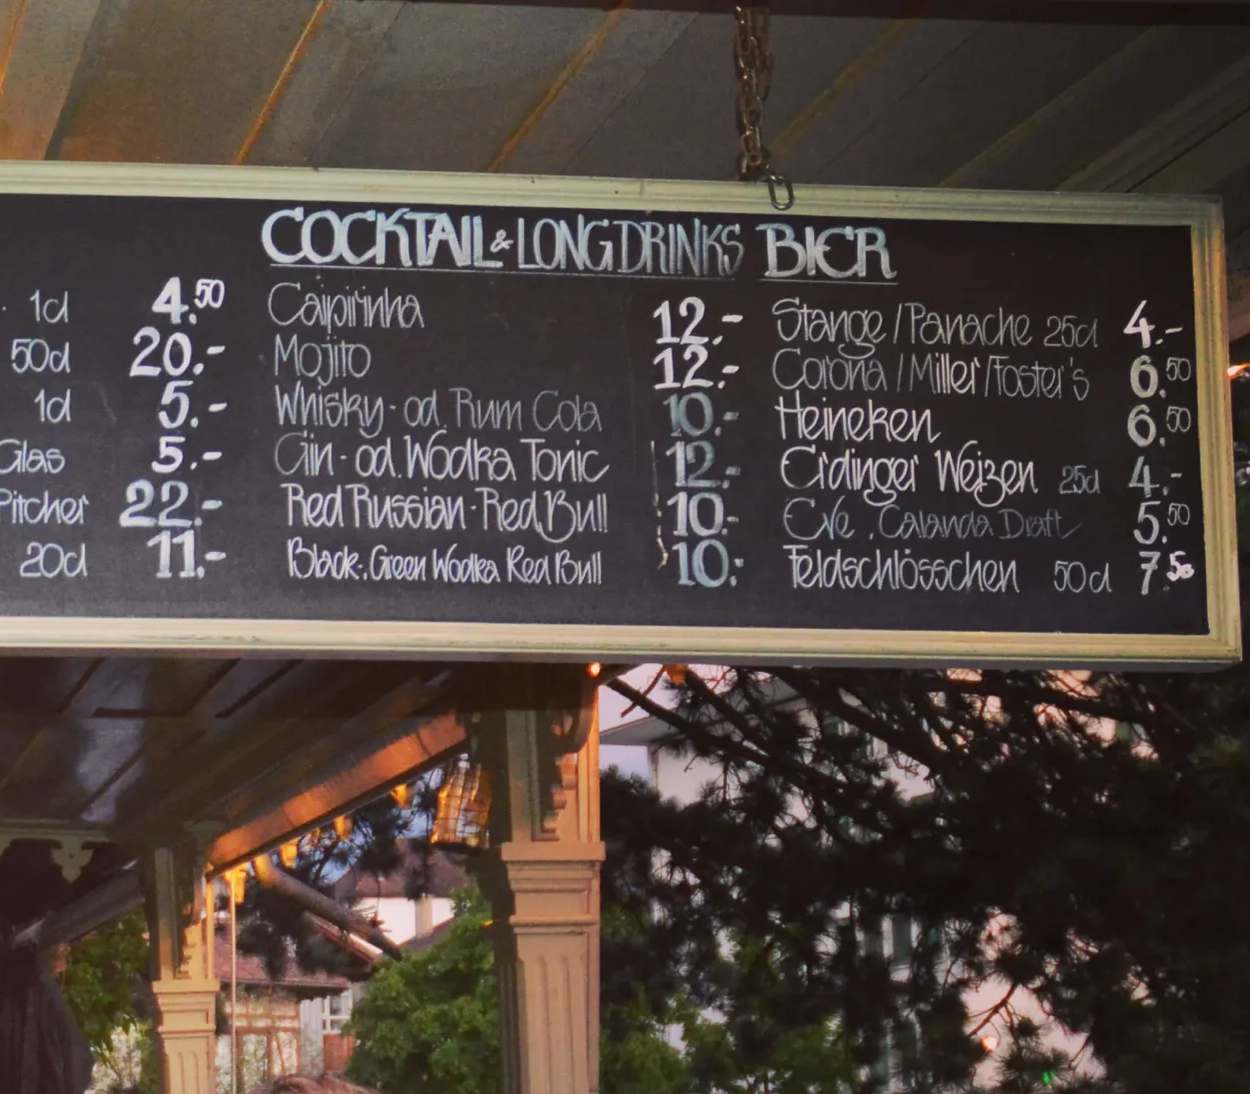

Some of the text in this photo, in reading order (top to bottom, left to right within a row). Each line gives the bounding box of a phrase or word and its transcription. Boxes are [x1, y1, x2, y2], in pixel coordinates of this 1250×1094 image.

[261, 206, 504, 269] COCKTAIL
[755, 222, 898, 280] BIER
[268, 282, 426, 336] Caipirinha
[772, 297, 887, 359] Stange
[274, 334, 372, 387] Mojito
[772, 347, 889, 392] Corona
[450, 387, 524, 432] Rum
[532, 390, 604, 432] Cola
[774, 391, 942, 442] Heineken
[404, 429, 517, 482] Wodka
[519, 438, 611, 483] Tonic
[935, 440, 1039, 508] Weizen
[280, 483, 345, 529] Red
[345, 483, 467, 531] Russian
[479, 486, 541, 534] Red
[537, 490, 609, 543] Bull
[878, 504, 993, 540] Calanda
[999, 506, 1083, 541] Draft
[370, 544, 427, 583] Green
[431, 544, 501, 585] Wodka
[506, 544, 553, 586] Red
[554, 548, 603, 586] Bull
